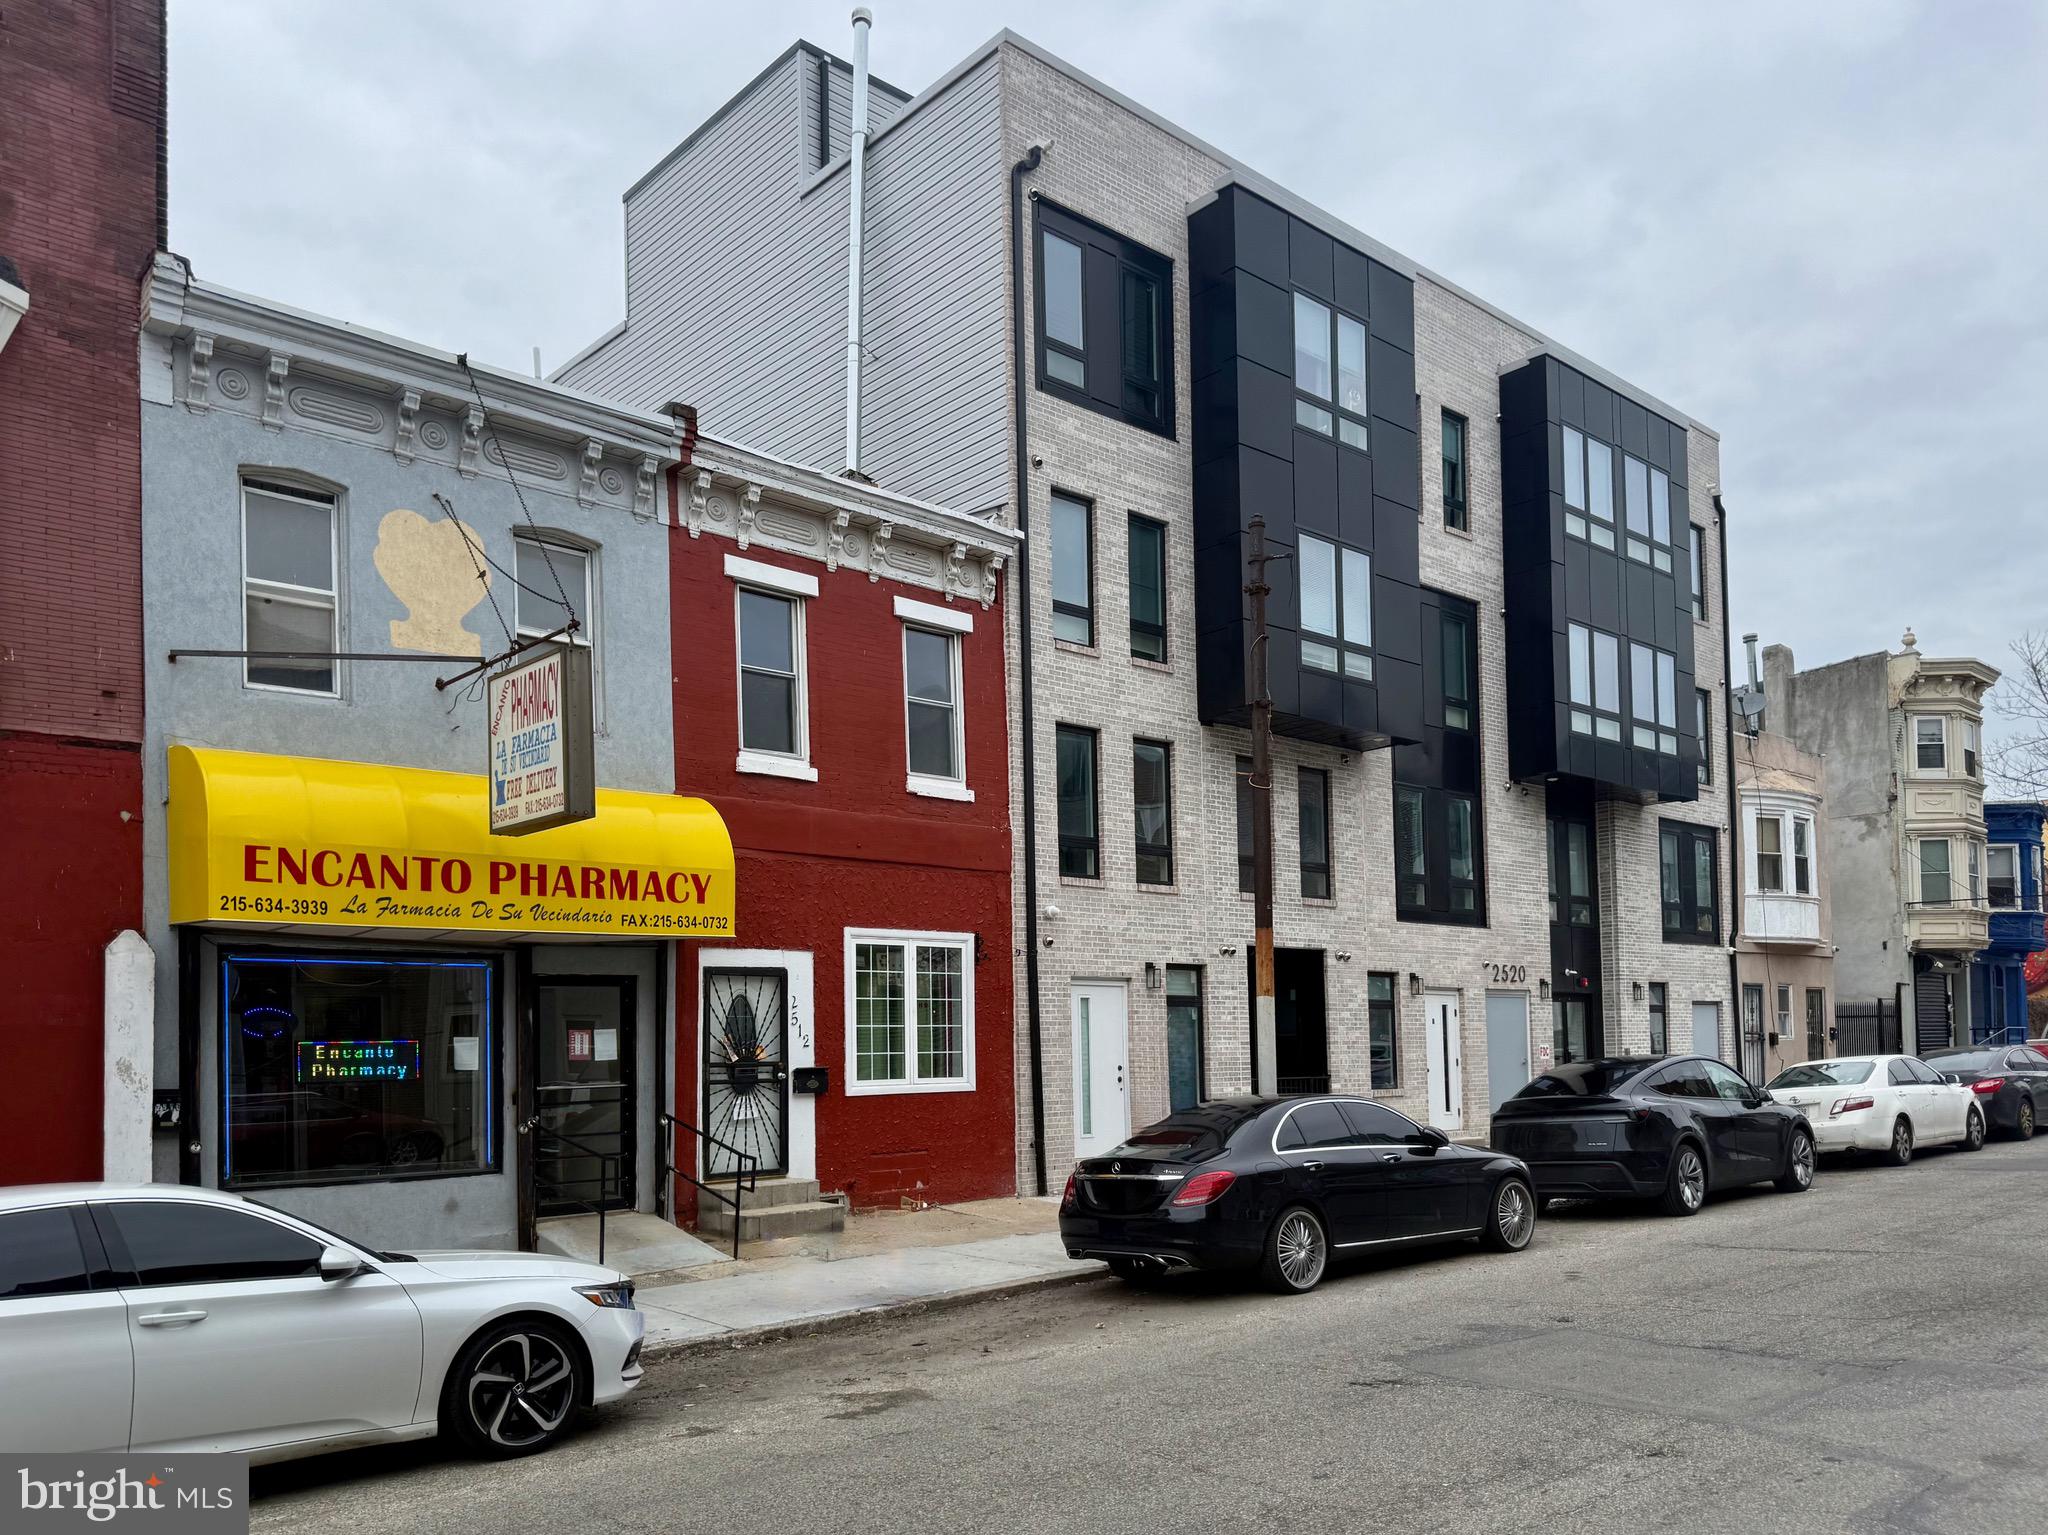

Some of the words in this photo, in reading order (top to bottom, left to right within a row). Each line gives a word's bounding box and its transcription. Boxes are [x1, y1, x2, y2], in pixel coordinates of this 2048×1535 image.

[491, 679, 511, 736] ENCANTO
[511, 660, 559, 732] PHARMACY
[496, 740, 507, 760] LA
[511, 722, 557, 754] FARMACIA
[506, 776, 523, 801] FREE
[526, 766, 557, 795] DELIVERY
[244, 844, 472, 894] ENCANTO
[489, 861, 712, 905] PHARMACY
[220, 895, 328, 916] 215-634-3939
[340, 894, 368, 915] La
[375, 896, 462, 918] Farmacia
[471, 900, 493, 919] De
[499, 903, 523, 921] Su
[529, 903, 614, 923] Vecindario
[1492, 964, 1526, 983] 2520
[312, 1064, 407, 1080] Pharmacy
